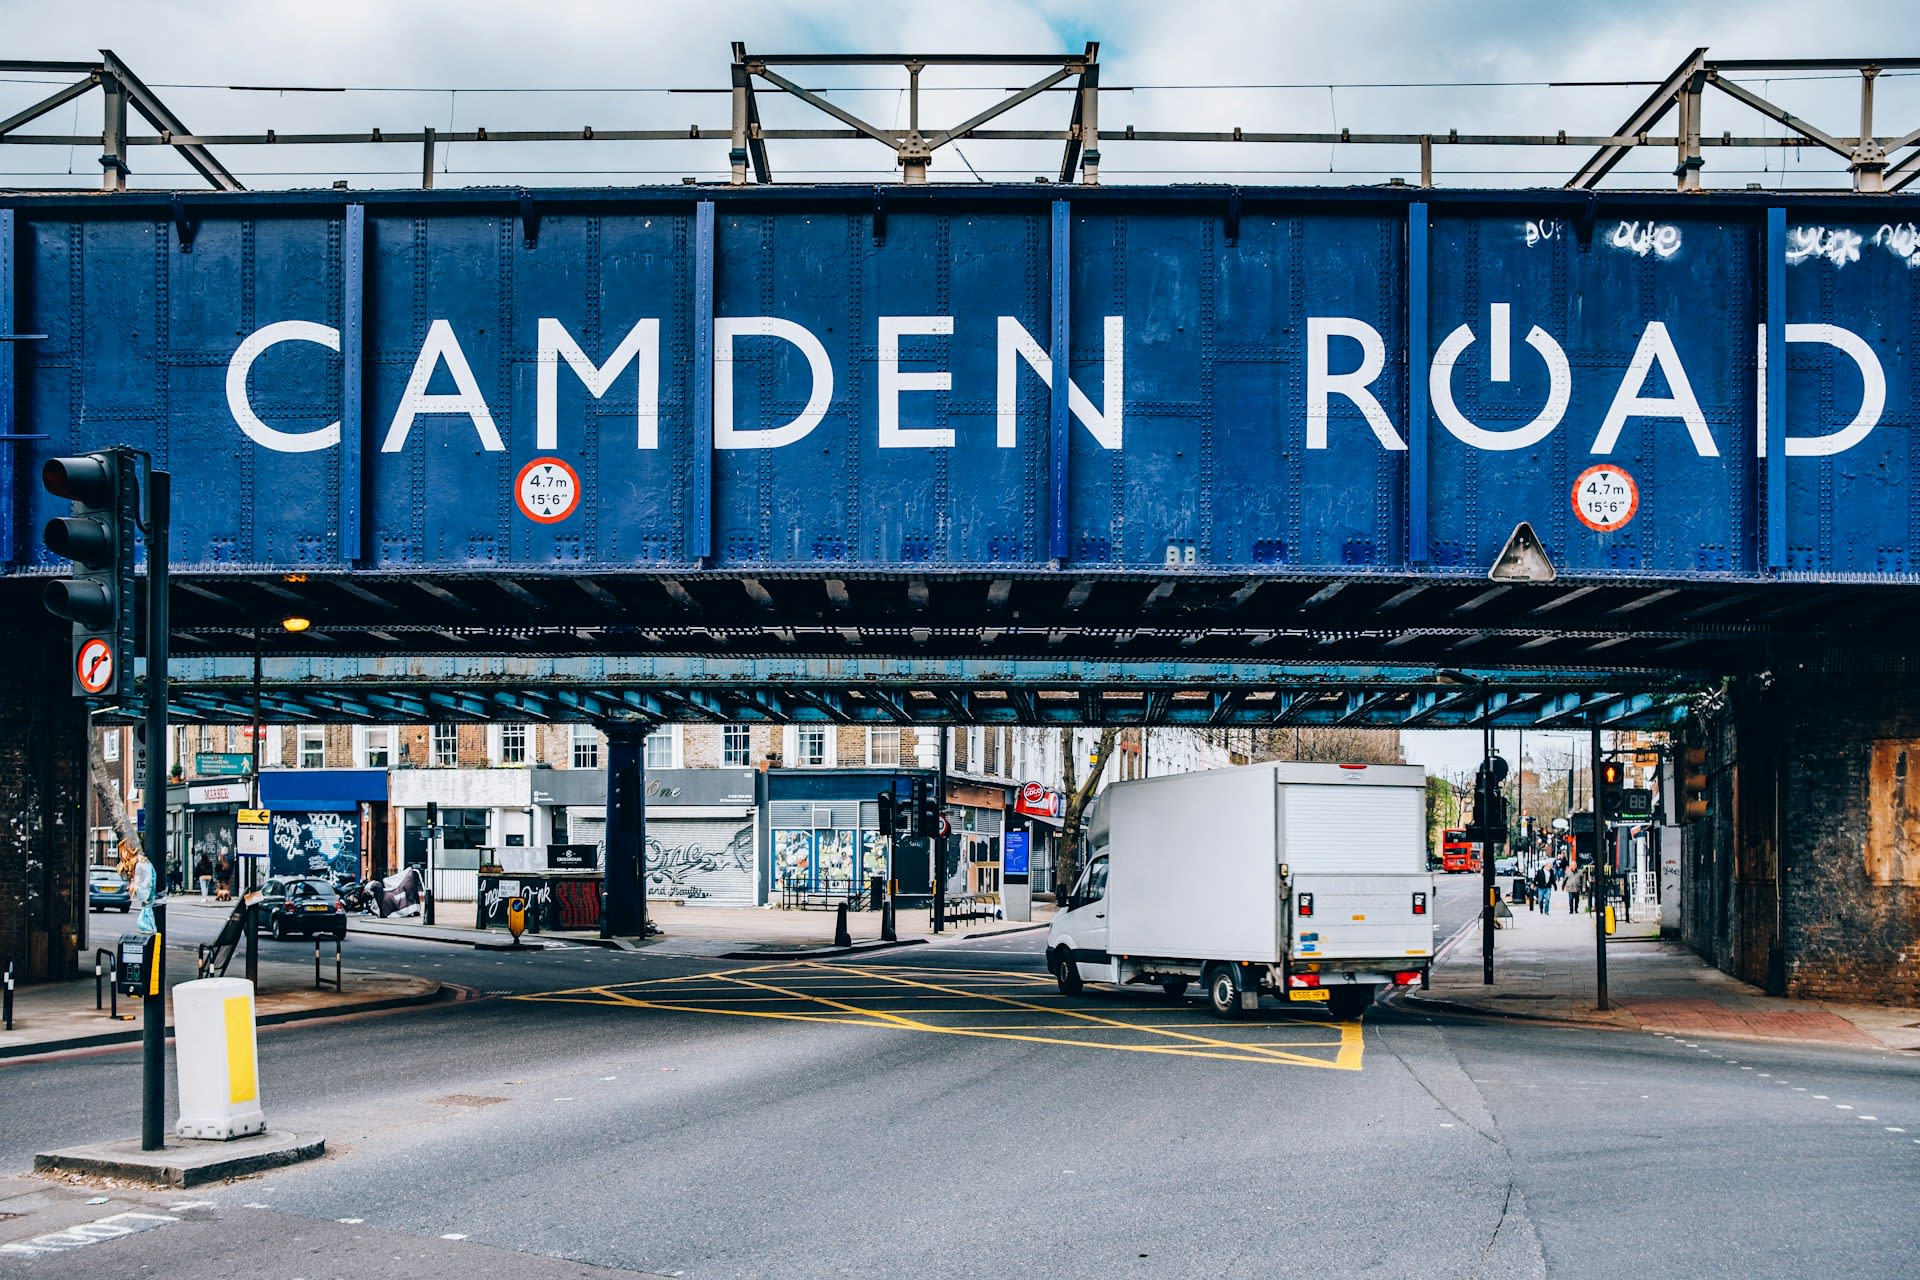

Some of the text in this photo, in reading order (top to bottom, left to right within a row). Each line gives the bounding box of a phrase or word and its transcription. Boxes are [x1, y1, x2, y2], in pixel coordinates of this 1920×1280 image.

[225, 303, 1887, 457] CAMDEN ROAD
[530, 474, 568, 488] 4.7m
[1586, 482, 1625, 495] 4.7m
[646, 779, 681, 798] One
